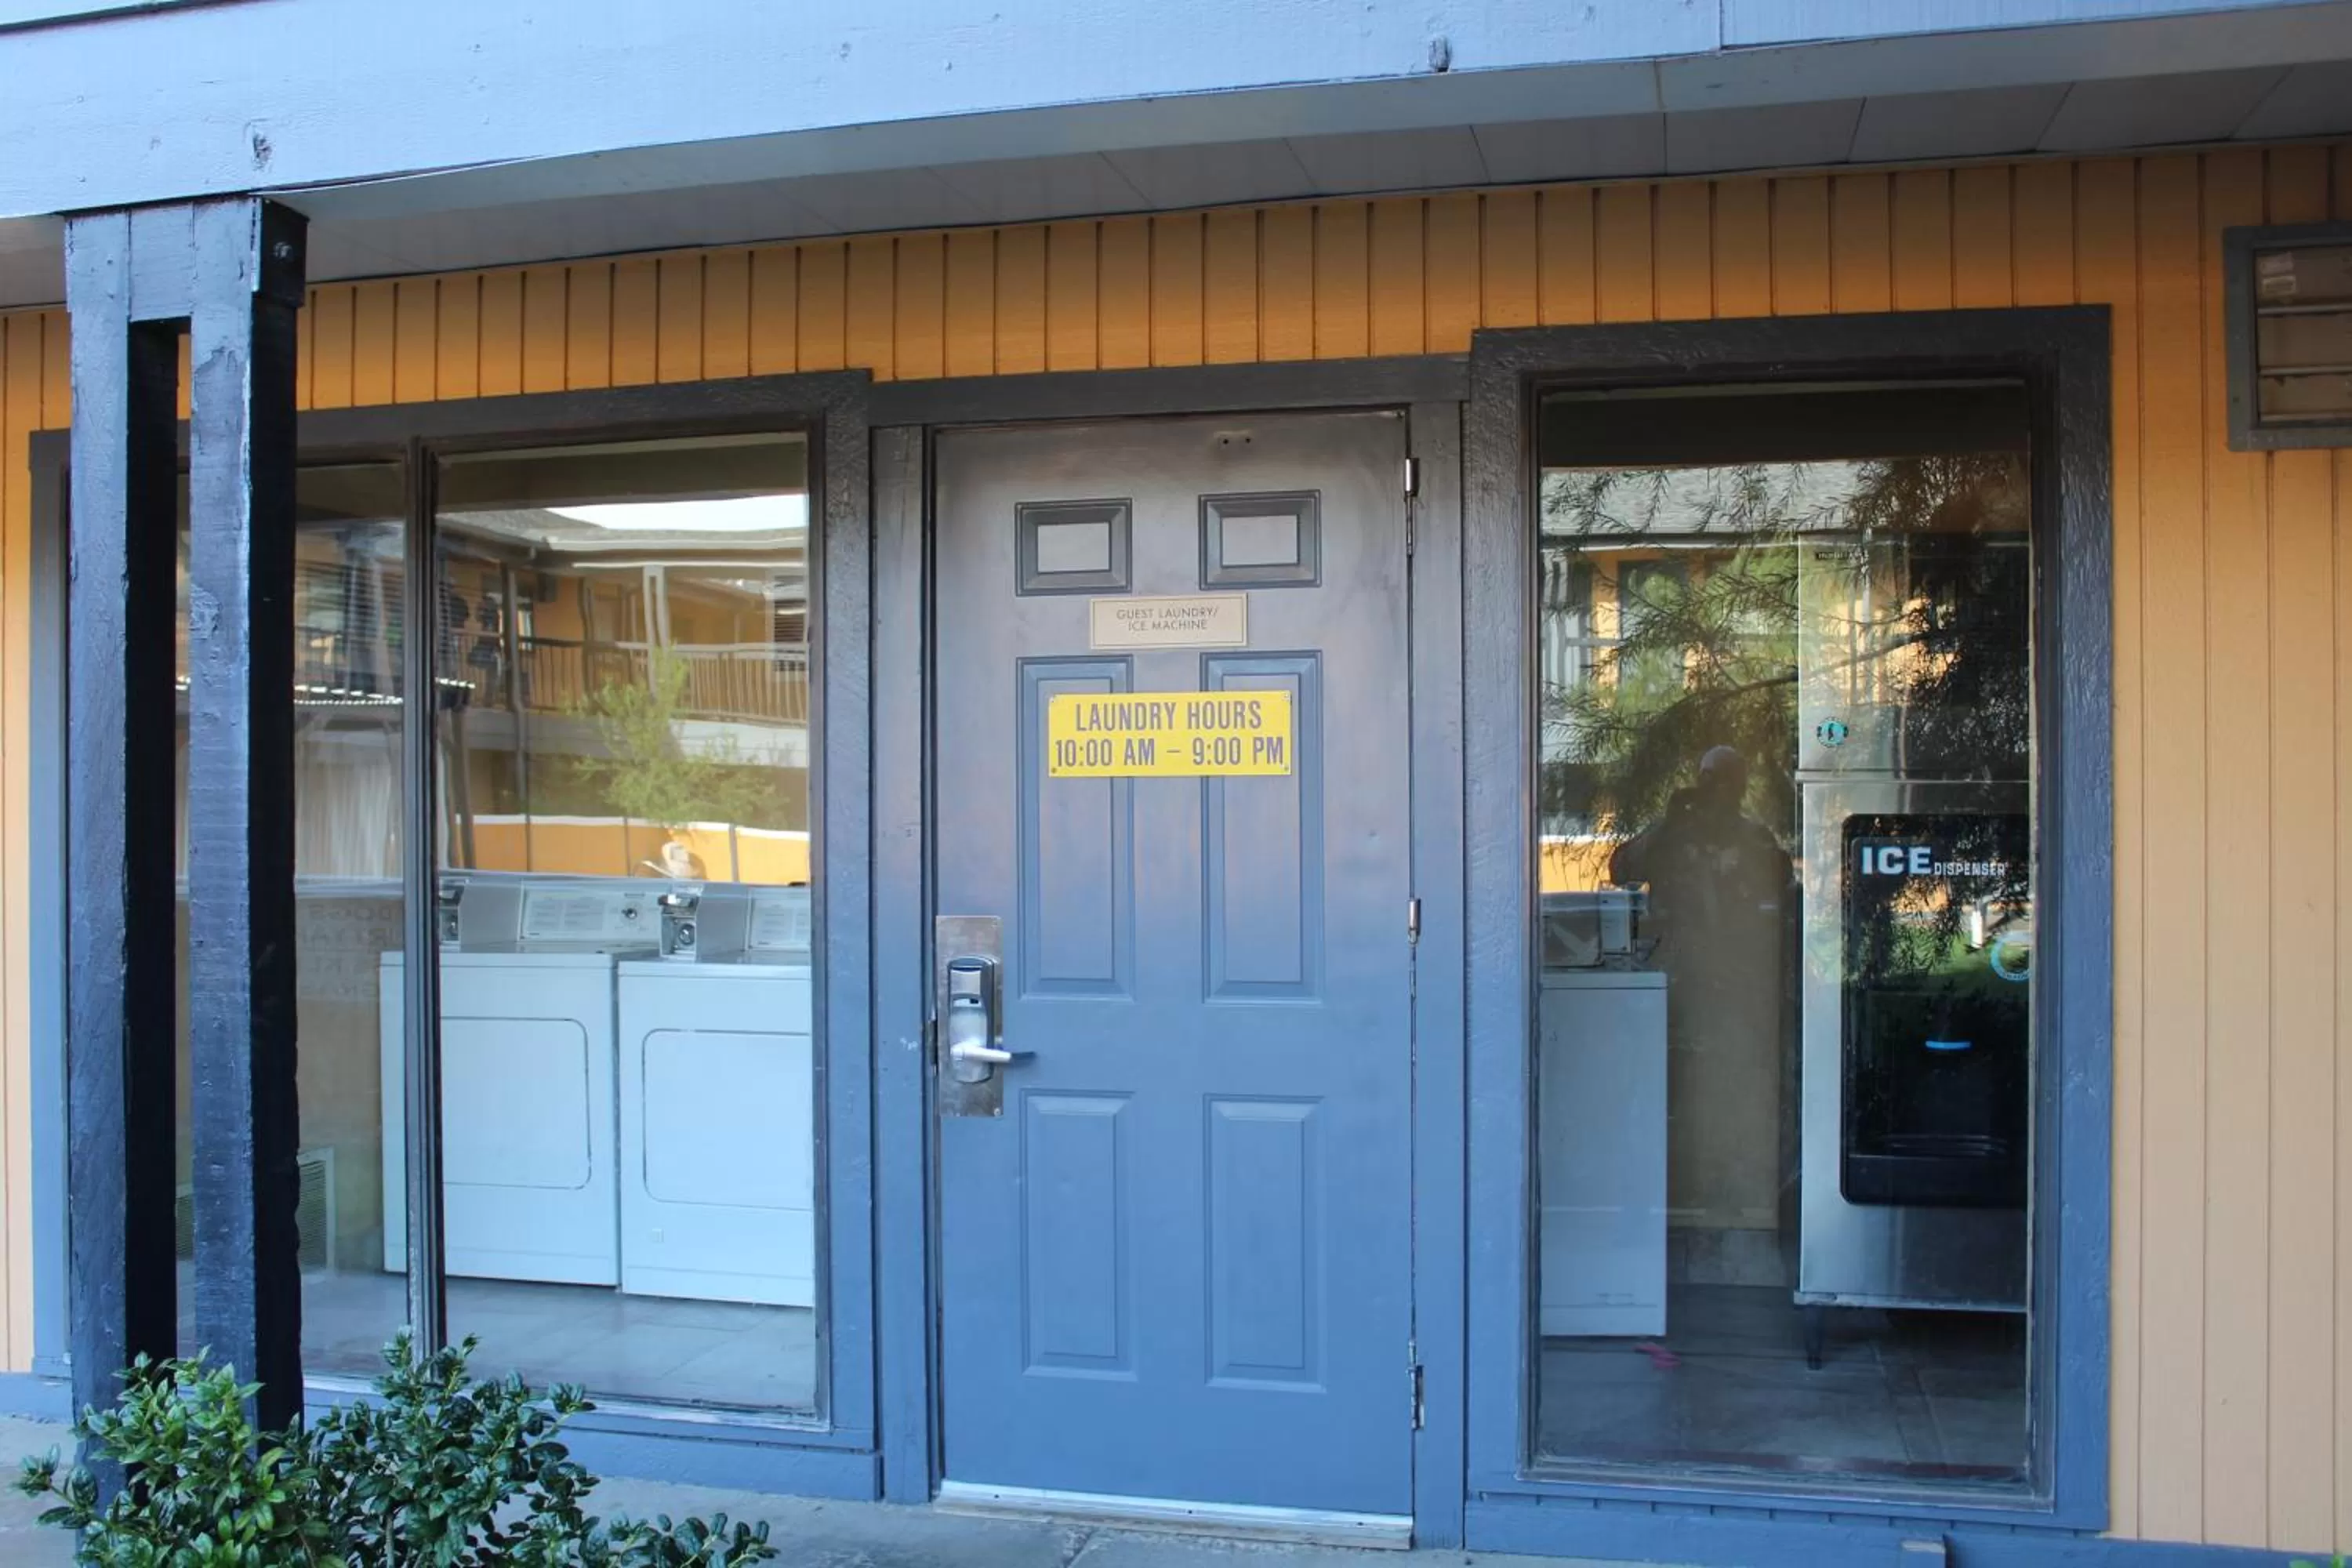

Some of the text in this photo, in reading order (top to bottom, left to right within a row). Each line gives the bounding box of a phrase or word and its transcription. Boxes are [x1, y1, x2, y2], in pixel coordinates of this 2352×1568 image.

[1116, 606, 1220, 620] GUEST LAUNDRY/
[1127, 619, 1209, 632] ICE MACHINE
[1076, 700, 1262, 732] LAUNDRY HOURS
[1054, 739, 1113, 768] 10:00
[1123, 738, 1155, 766] AM
[1192, 737, 1241, 766] 9:00
[1253, 736, 1283, 765] PM
[1861, 846, 2005, 876] ICE DISPENSER
